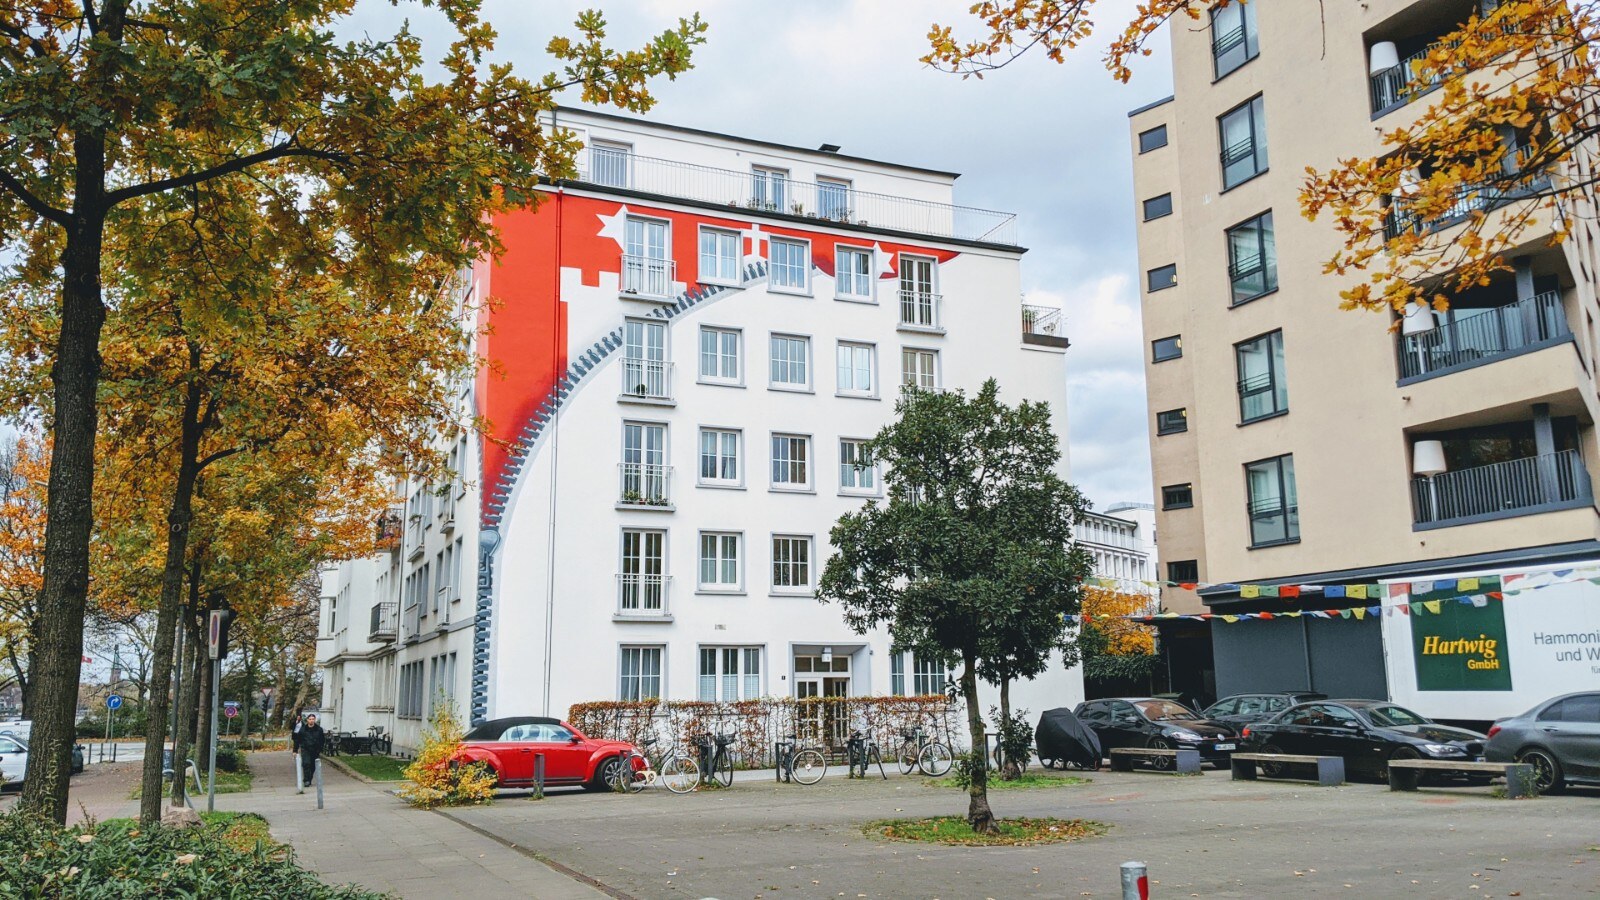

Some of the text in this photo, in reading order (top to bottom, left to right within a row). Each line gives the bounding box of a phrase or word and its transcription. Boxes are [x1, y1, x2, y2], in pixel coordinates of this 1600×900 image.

[1422, 634, 1497, 658] Hartwig
[1556, 648, 1582, 661] und
[1467, 659, 1500, 669] GmbH
